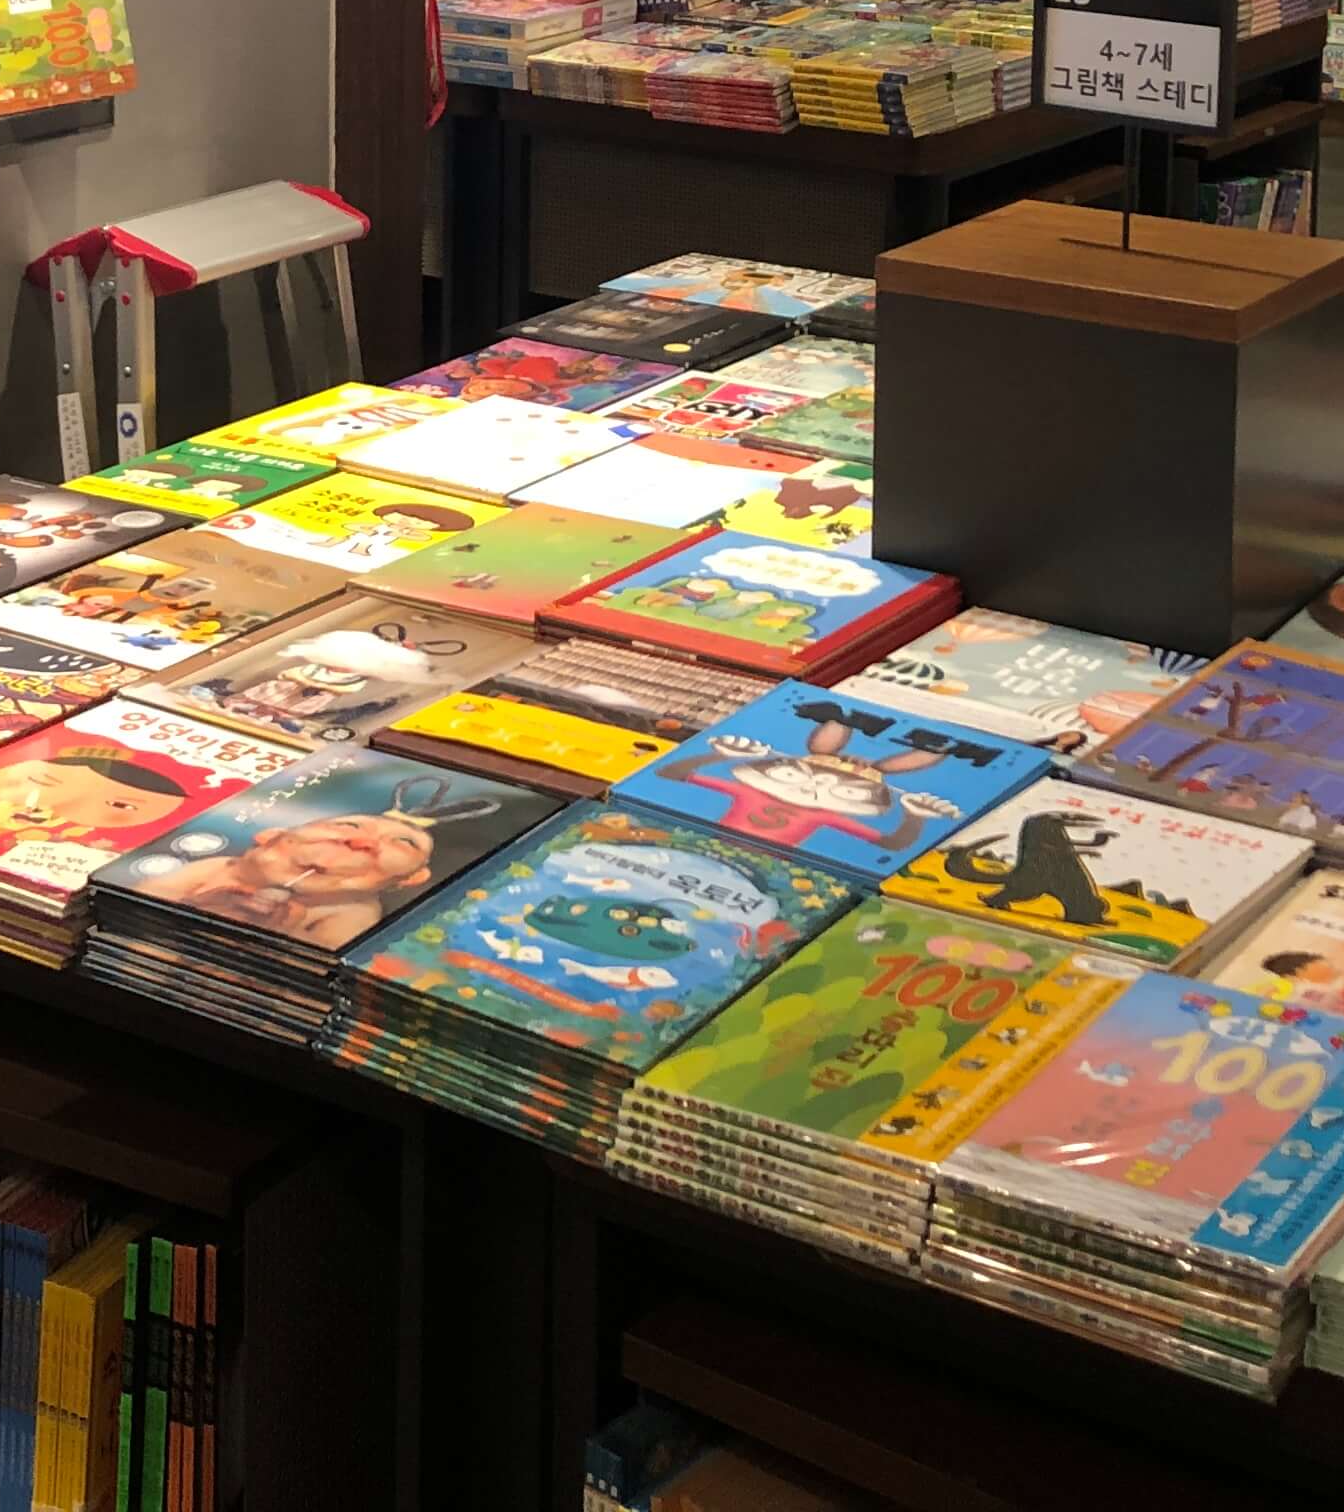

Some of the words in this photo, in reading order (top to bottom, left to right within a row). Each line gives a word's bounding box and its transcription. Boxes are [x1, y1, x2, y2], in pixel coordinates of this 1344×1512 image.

[1099, 39, 1174, 72] 4~7세
[1050, 66, 1125, 102] 그림책
[1136, 76, 1213, 113] 스테디
[668, 871, 768, 915] 옥토넛
[861, 953, 1018, 1025] 100
[1152, 1031, 1331, 1112] 100
